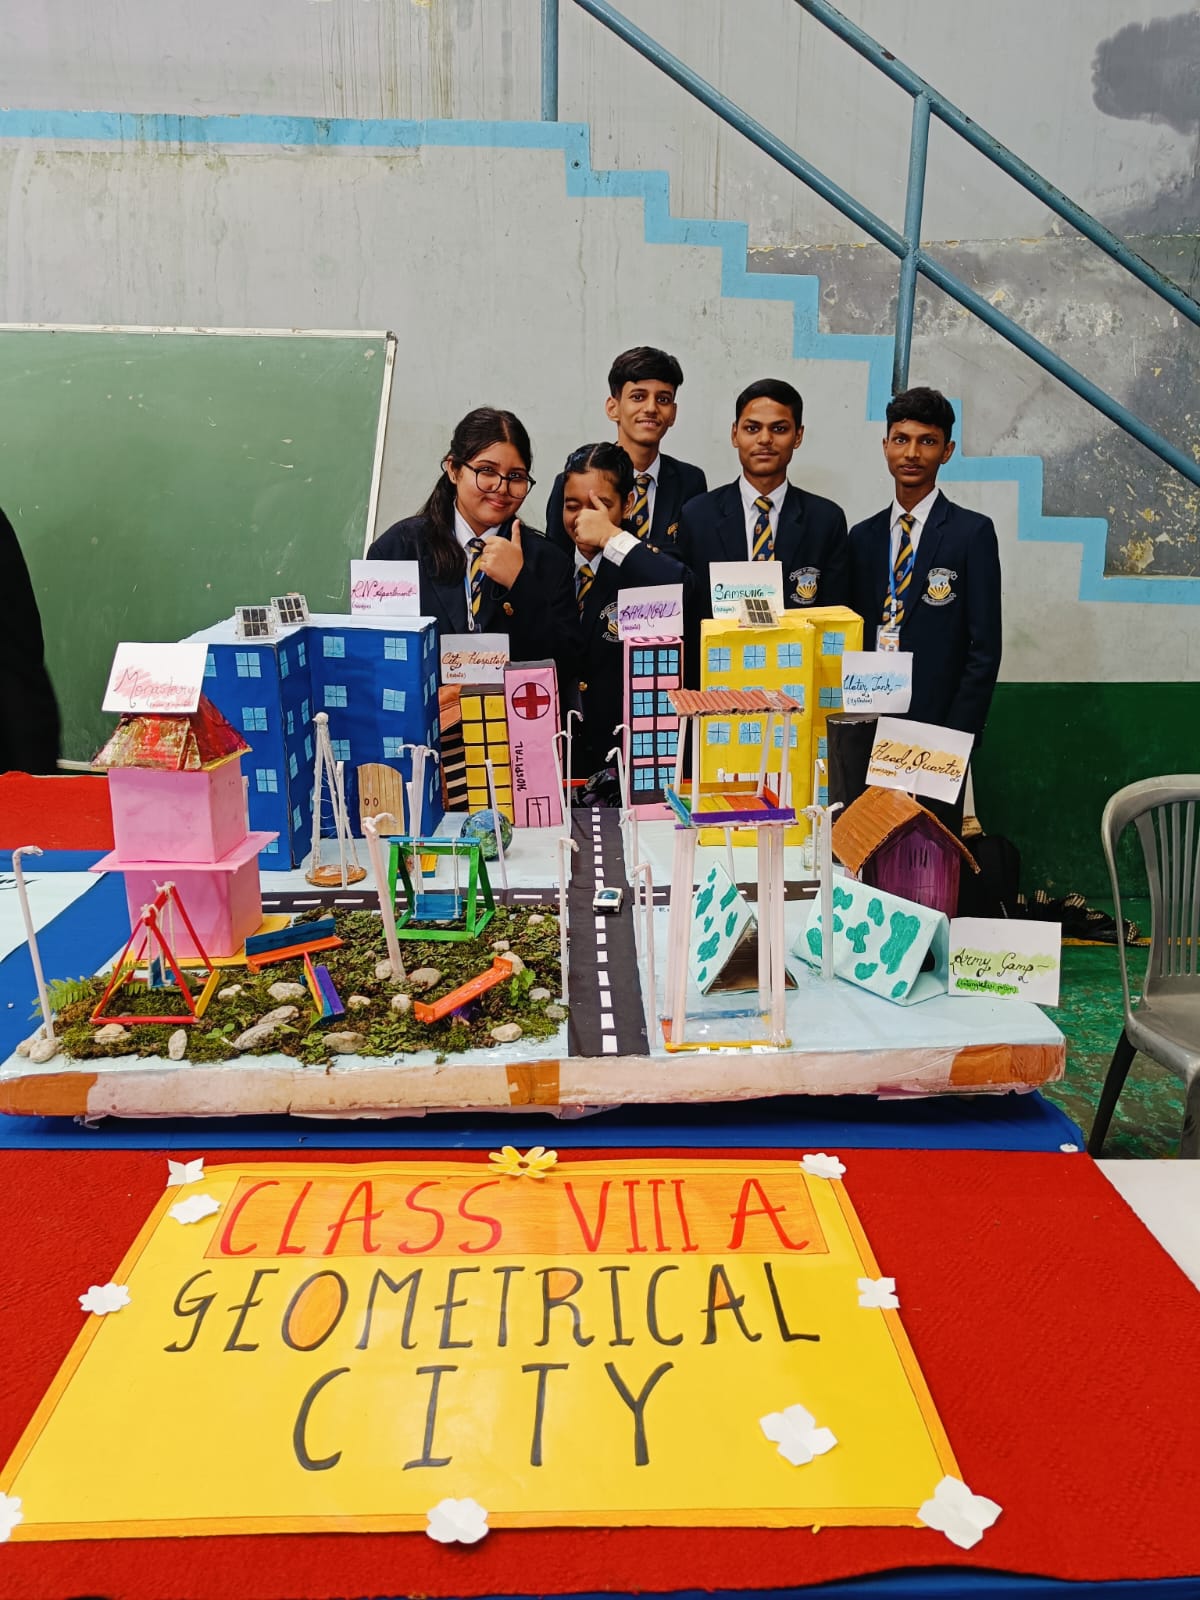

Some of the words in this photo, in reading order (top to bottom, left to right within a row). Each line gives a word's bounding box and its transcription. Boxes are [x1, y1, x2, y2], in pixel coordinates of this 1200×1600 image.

[714, 583, 764, 601] SAMSUNG
[515, 741, 527, 793] HOSPITAL
[950, 948, 991, 978] Army
[220, 1180, 502, 1255] CLASS
[563, 1179, 699, 1254] VIII
[727, 1179, 810, 1253] A
[164, 1262, 821, 1353] GEOMETRICAL
[293, 1362, 674, 1471] CITY
